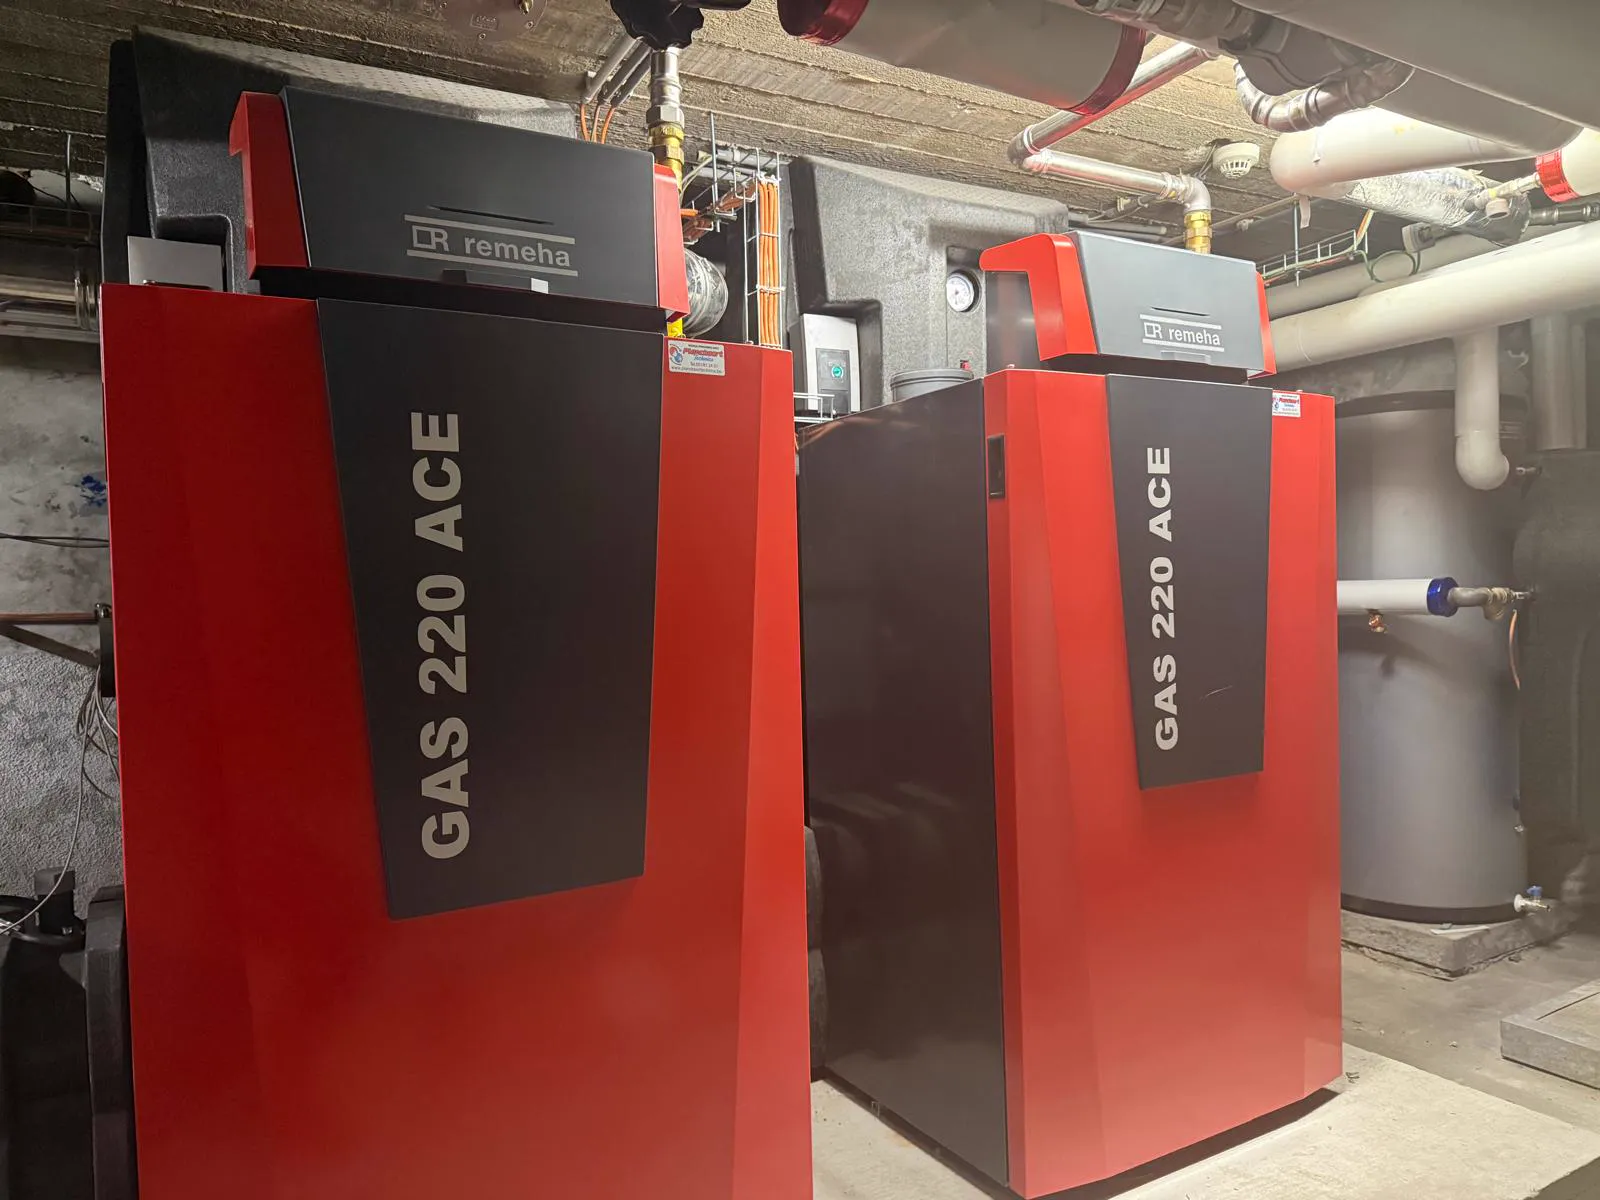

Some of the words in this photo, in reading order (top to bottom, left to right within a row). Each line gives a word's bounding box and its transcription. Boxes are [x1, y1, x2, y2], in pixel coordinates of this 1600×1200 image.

[464, 236, 571, 267] remeha
[1168, 328, 1221, 346] remeha
[411, 412, 463, 552] ACE
[1146, 447, 1173, 543] ACE
[416, 574, 466, 695] 220
[1149, 556, 1175, 639] 220
[1152, 654, 1179, 751] GAS
[420, 717, 470, 859] GAS
